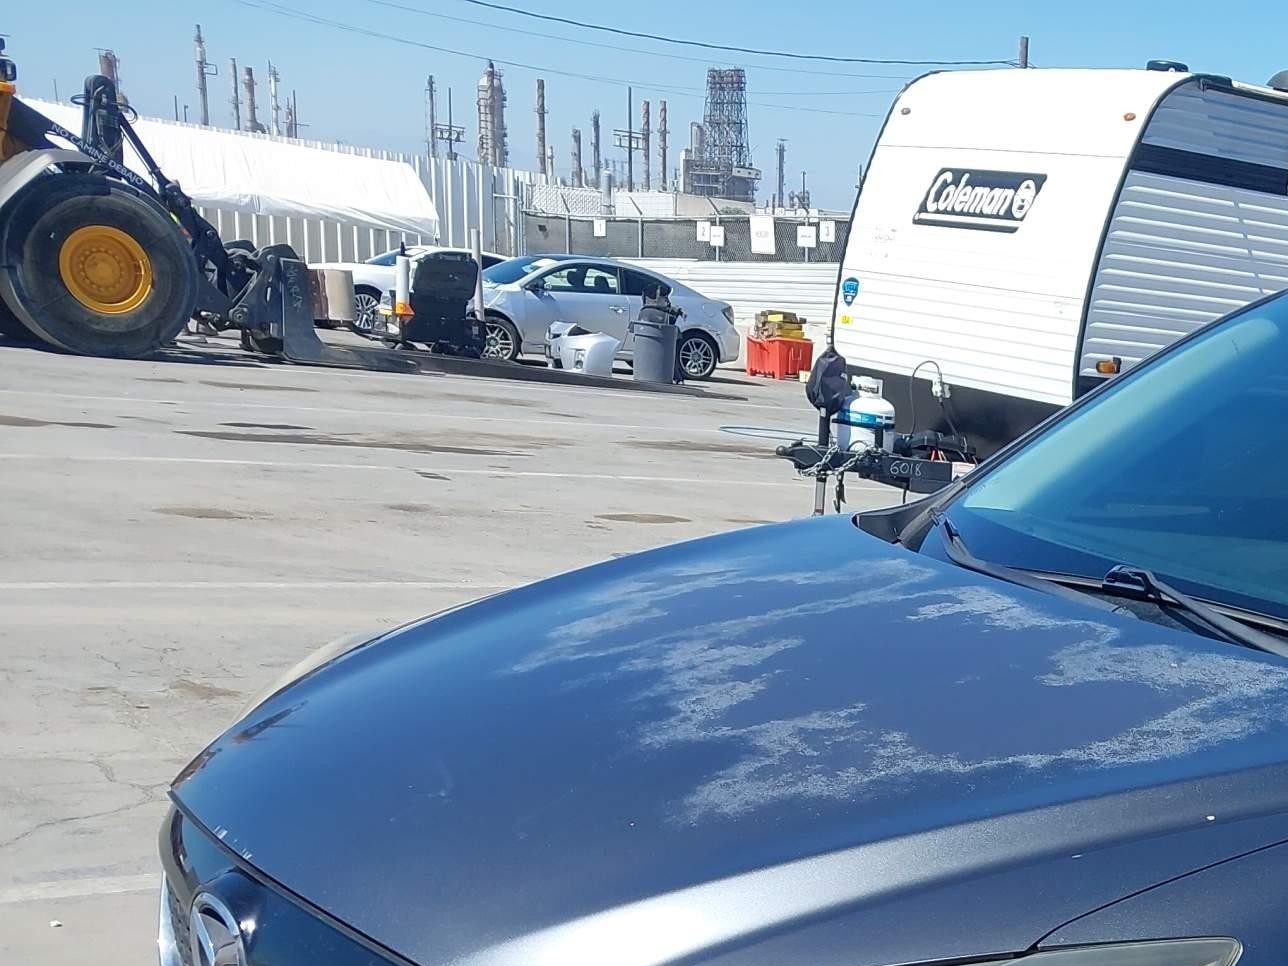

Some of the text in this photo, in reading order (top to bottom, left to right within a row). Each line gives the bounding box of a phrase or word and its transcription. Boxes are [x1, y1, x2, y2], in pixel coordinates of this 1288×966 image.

[51, 124, 144, 185] NO CAMINE DEBAJO
[926, 171, 1016, 216] Coleman
[889, 460, 922, 477] 6018
